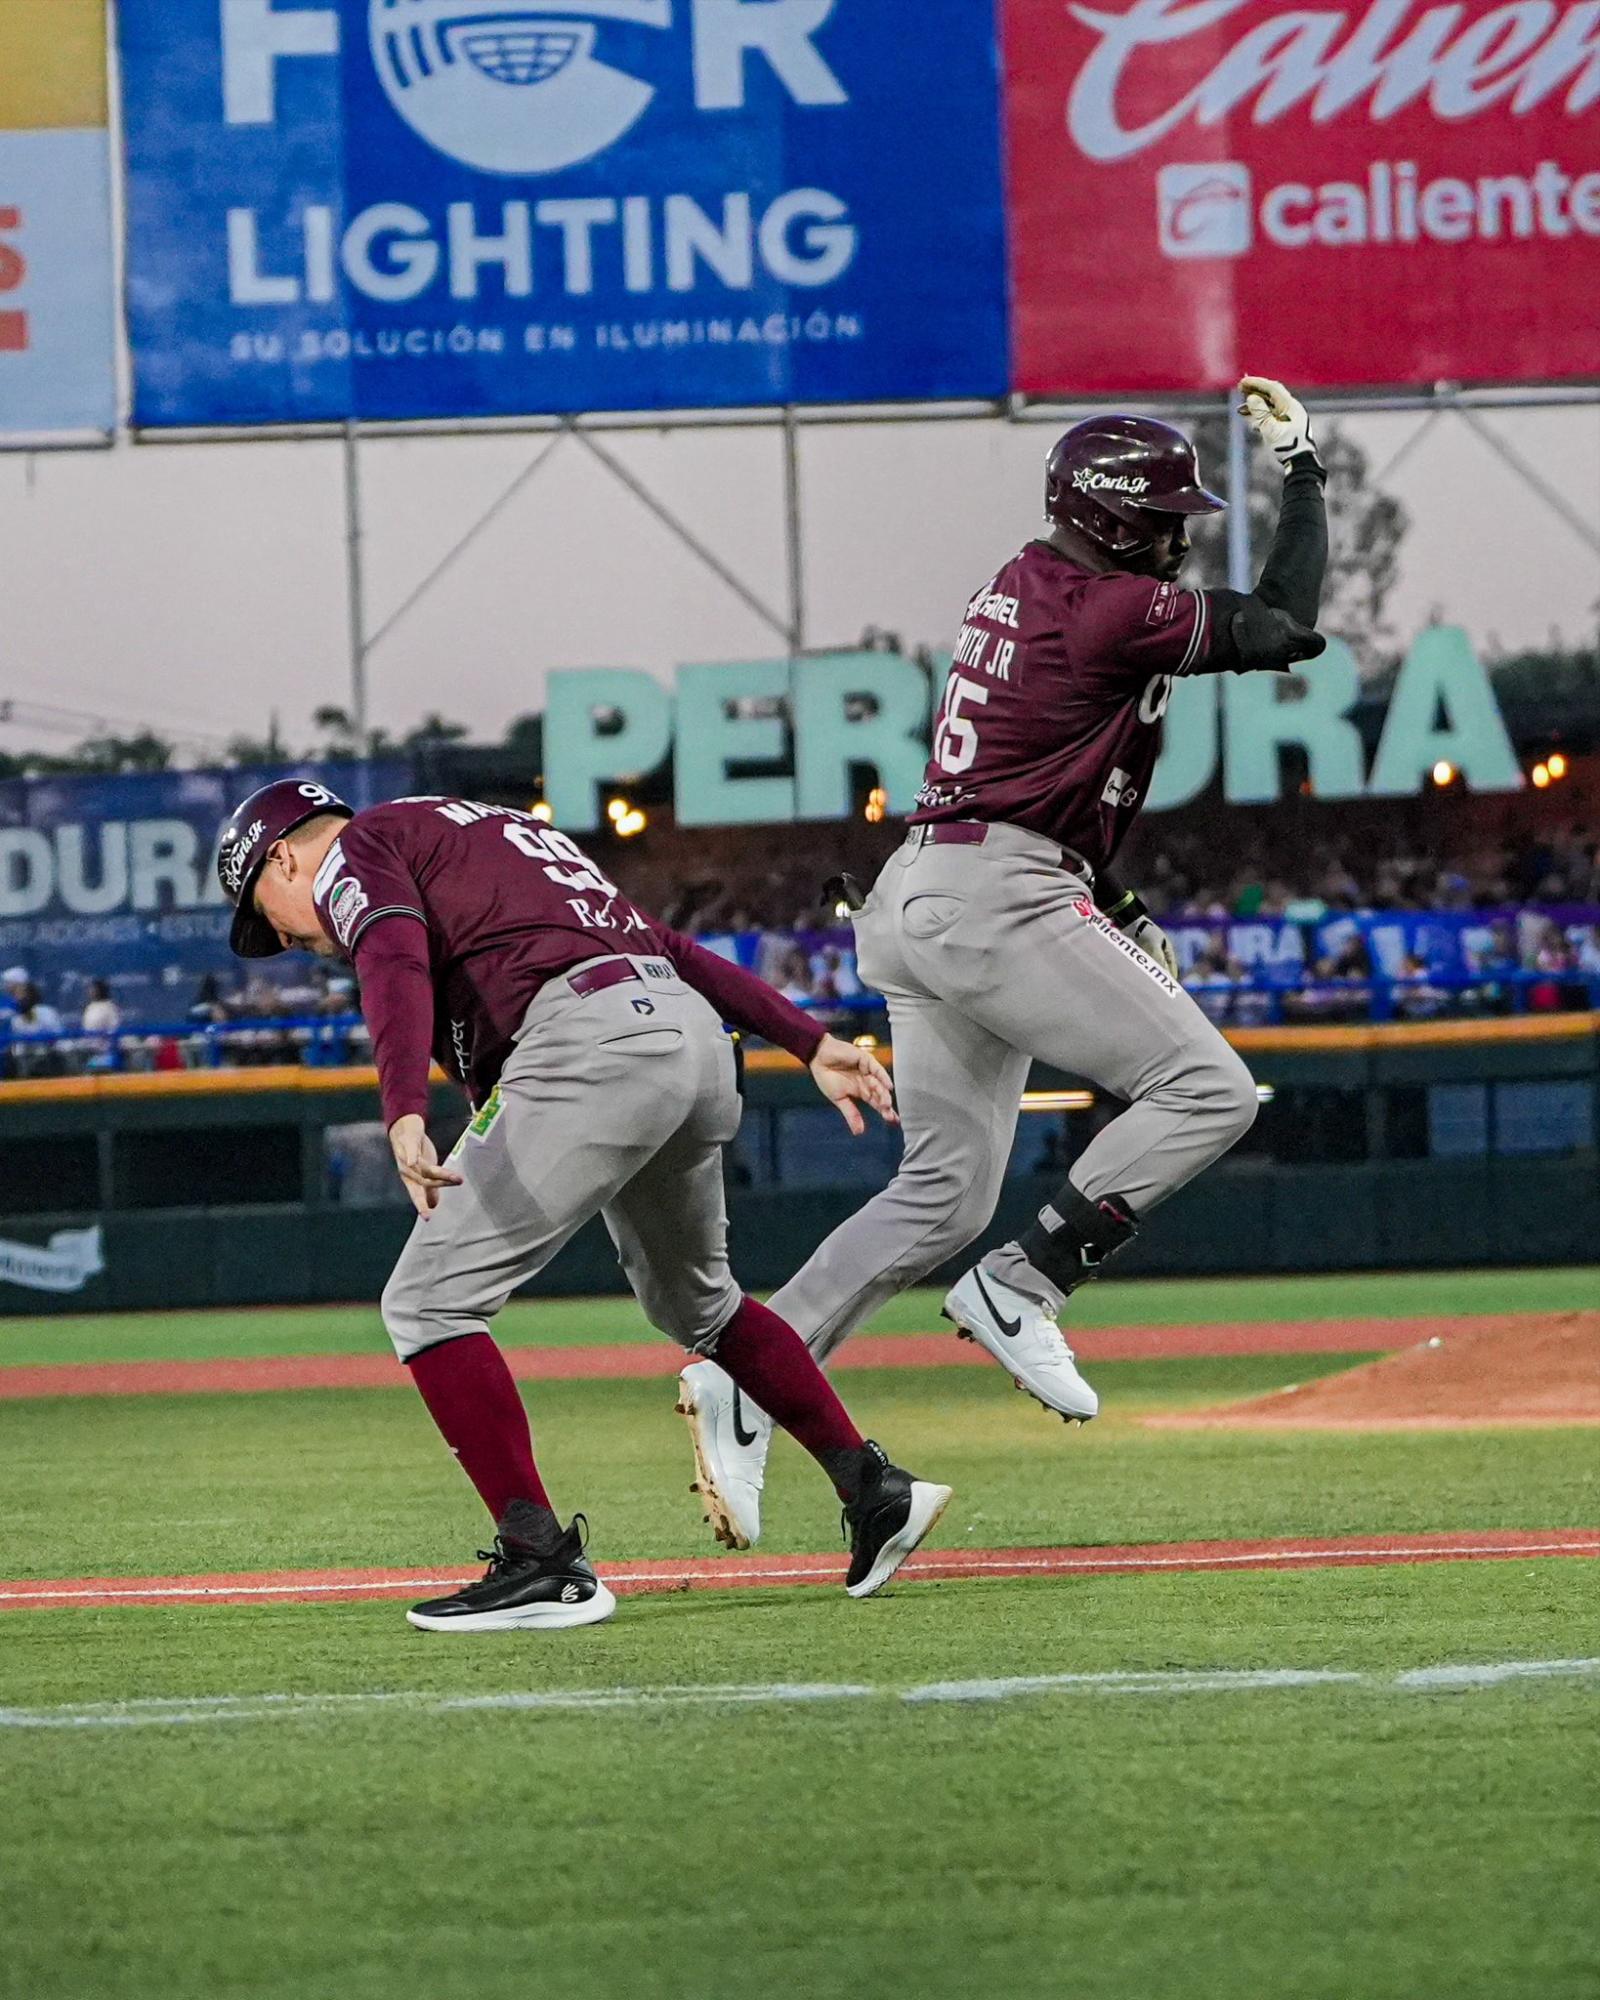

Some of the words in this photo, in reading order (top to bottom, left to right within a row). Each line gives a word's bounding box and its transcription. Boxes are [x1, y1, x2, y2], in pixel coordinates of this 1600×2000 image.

[227, 188, 857, 305] LIGHTING
[298, 325, 504, 359] SOLUCIÓN
[525, 325, 575, 352] EN
[595, 309, 862, 350] ILUMINACIÓN
[985, 637, 1016, 681] JR
[934, 671, 989, 775] 15
[503, 822, 619, 899] 99
